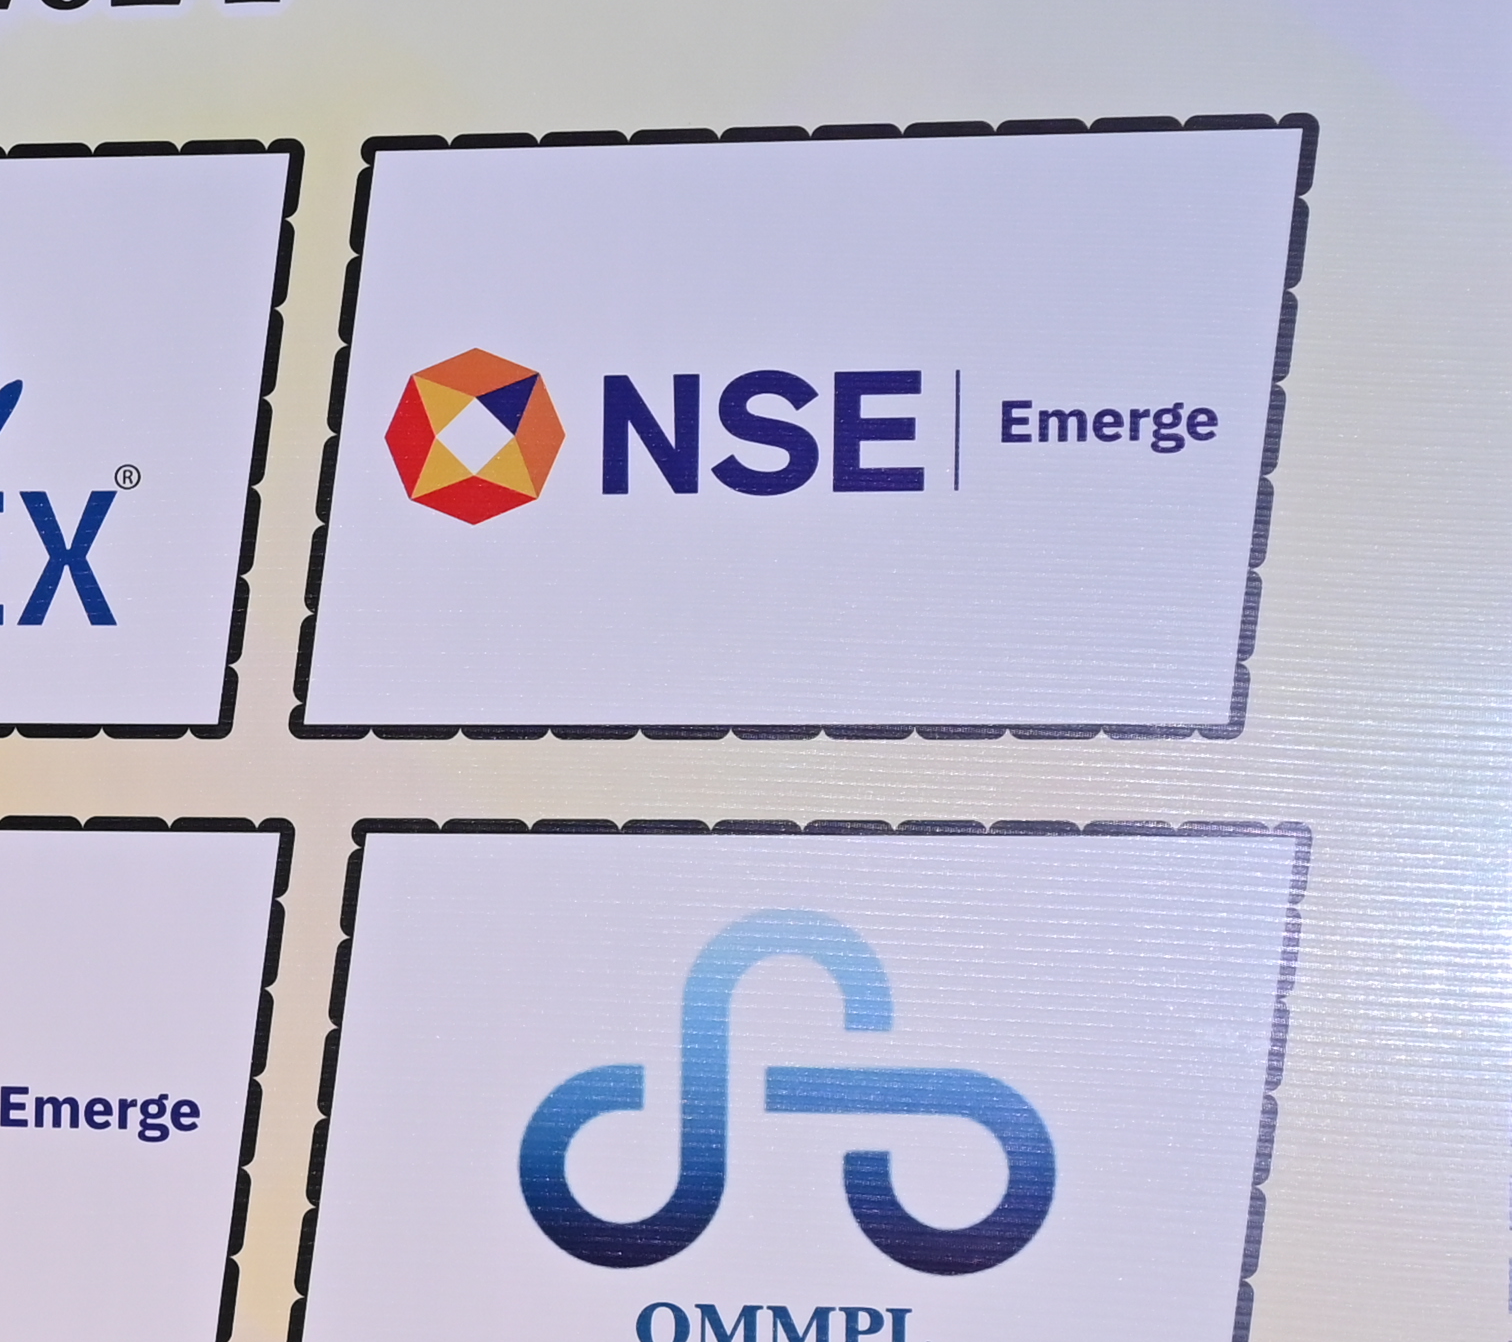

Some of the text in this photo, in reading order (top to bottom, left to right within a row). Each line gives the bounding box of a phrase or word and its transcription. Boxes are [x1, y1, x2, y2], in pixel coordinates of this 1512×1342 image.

[603, 370, 1218, 496] NSE Emerge
[0, 1086, 200, 1142] Emerge
